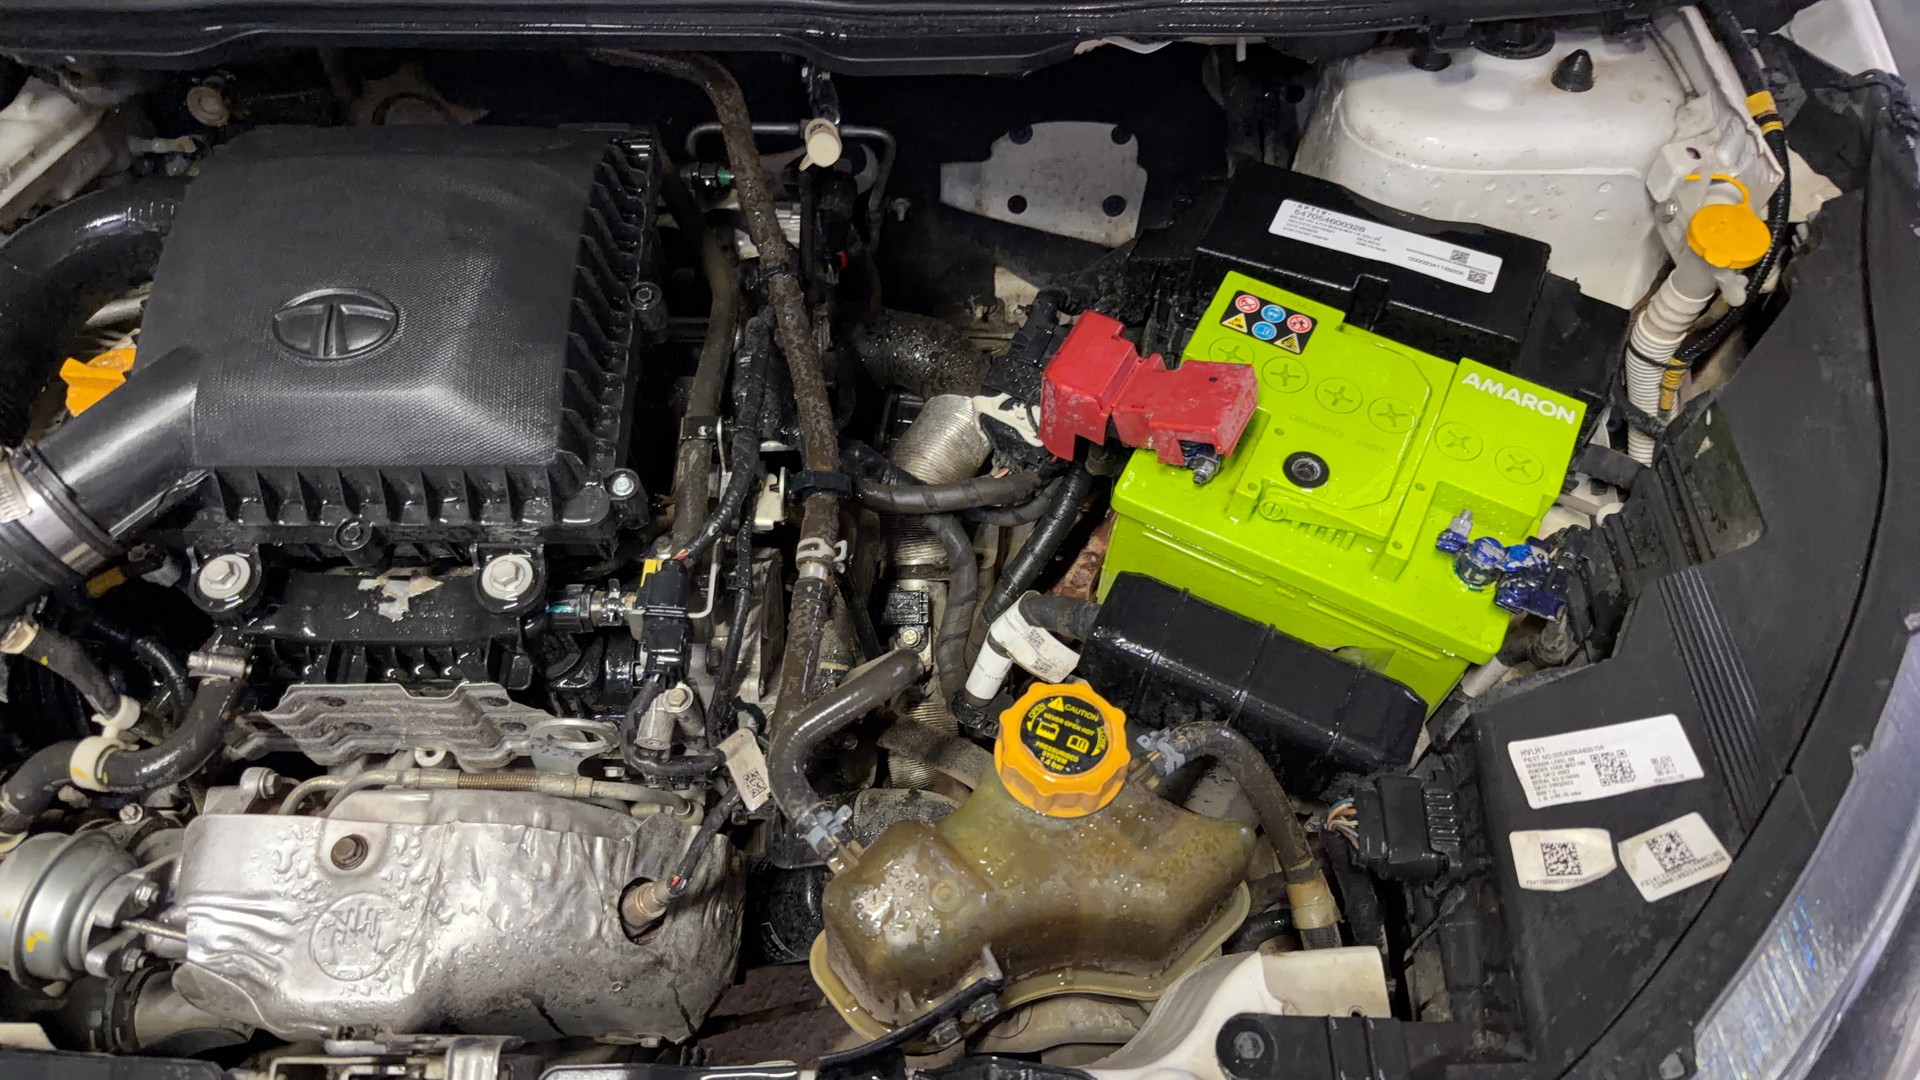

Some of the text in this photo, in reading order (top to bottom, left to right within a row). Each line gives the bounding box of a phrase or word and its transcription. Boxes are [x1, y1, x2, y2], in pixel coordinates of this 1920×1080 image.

[1297, 204, 1328, 216] APTIV
[1461, 372, 1576, 425] AMARON
[1028, 702, 1047, 719] OPEN
[1064, 703, 1099, 722] CAUTION
[1043, 712, 1095, 737] NEVER OPEN HOT
[1035, 740, 1080, 763] PRESSURISED
[1041, 750, 1069, 765] SYSTEM
[1051, 761, 1065, 771] bar
